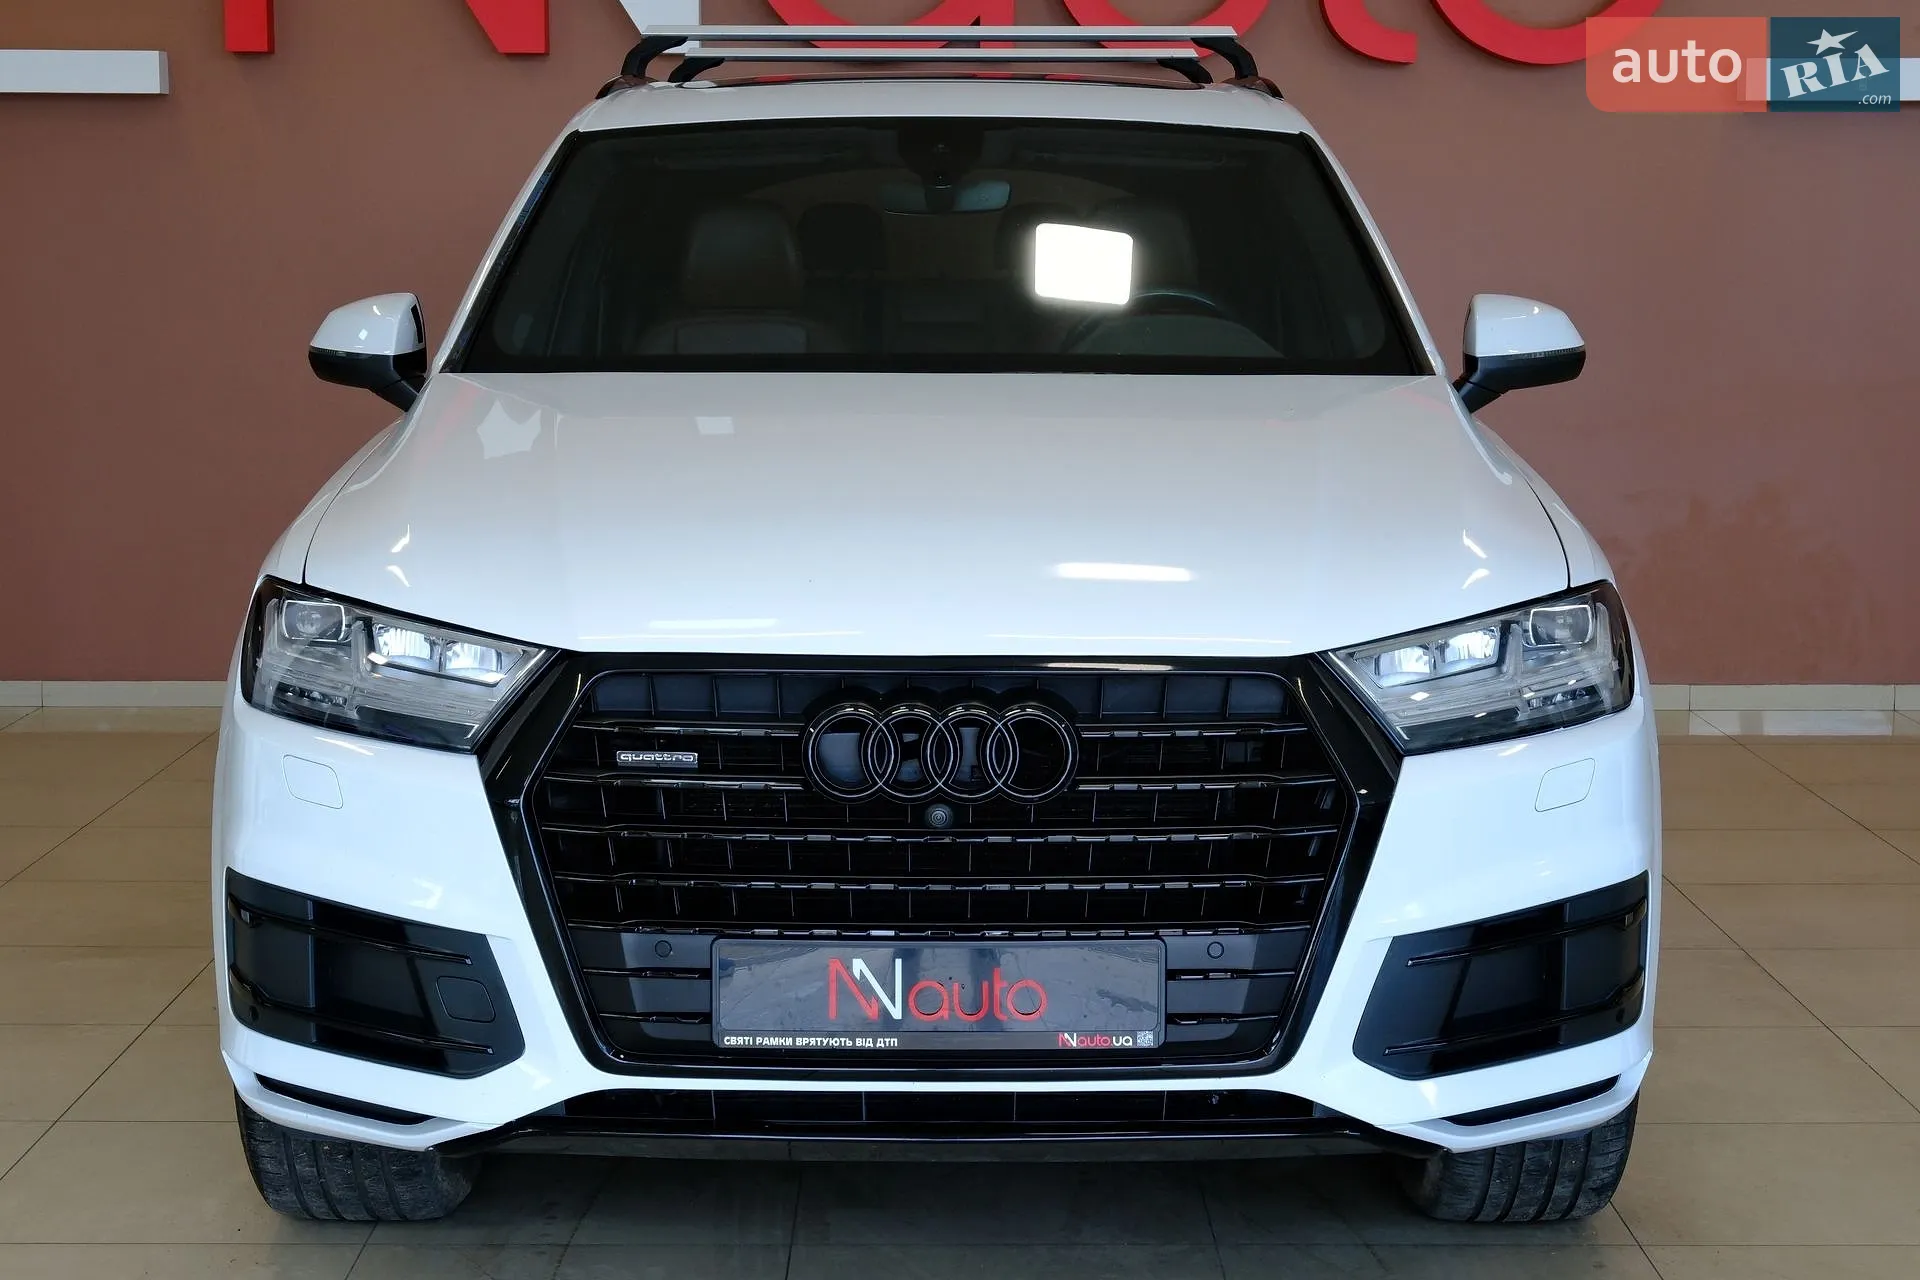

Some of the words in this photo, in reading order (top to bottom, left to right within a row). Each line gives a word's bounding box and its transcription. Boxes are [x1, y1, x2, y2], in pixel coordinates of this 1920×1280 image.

[619, 753, 694, 762] quattro
[723, 1036, 753, 1046] СВЯТІ
[755, 1036, 793, 1046] РАМКИ
[795, 1037, 853, 1048] ВРЯТУЮТЬ
[855, 1037, 874, 1047] ВІД
[876, 1037, 898, 1048] ДТП
